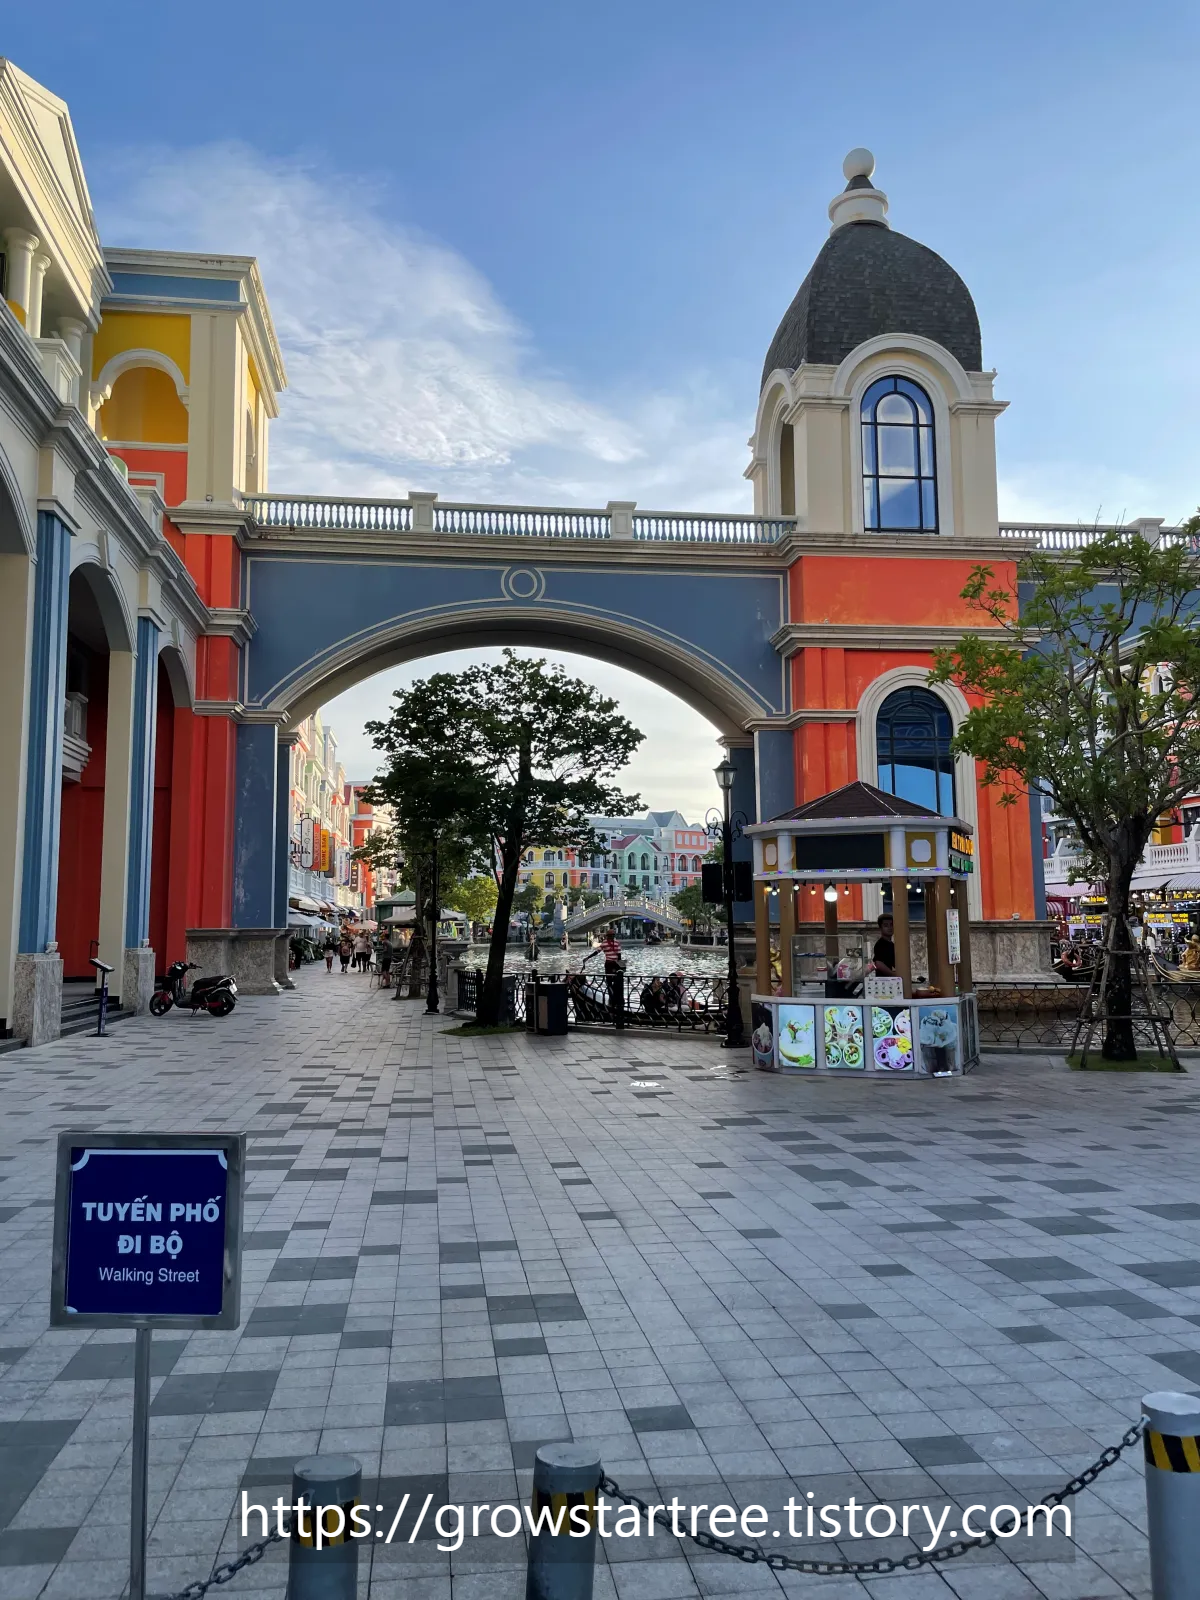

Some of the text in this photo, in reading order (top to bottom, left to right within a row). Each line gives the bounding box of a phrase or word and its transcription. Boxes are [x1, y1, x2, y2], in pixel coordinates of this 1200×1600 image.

[82, 1195, 222, 1223] TUYẾN PHỐ
[117, 1230, 183, 1259] ĐI BỘ
[98, 1267, 200, 1286] Walking Street
